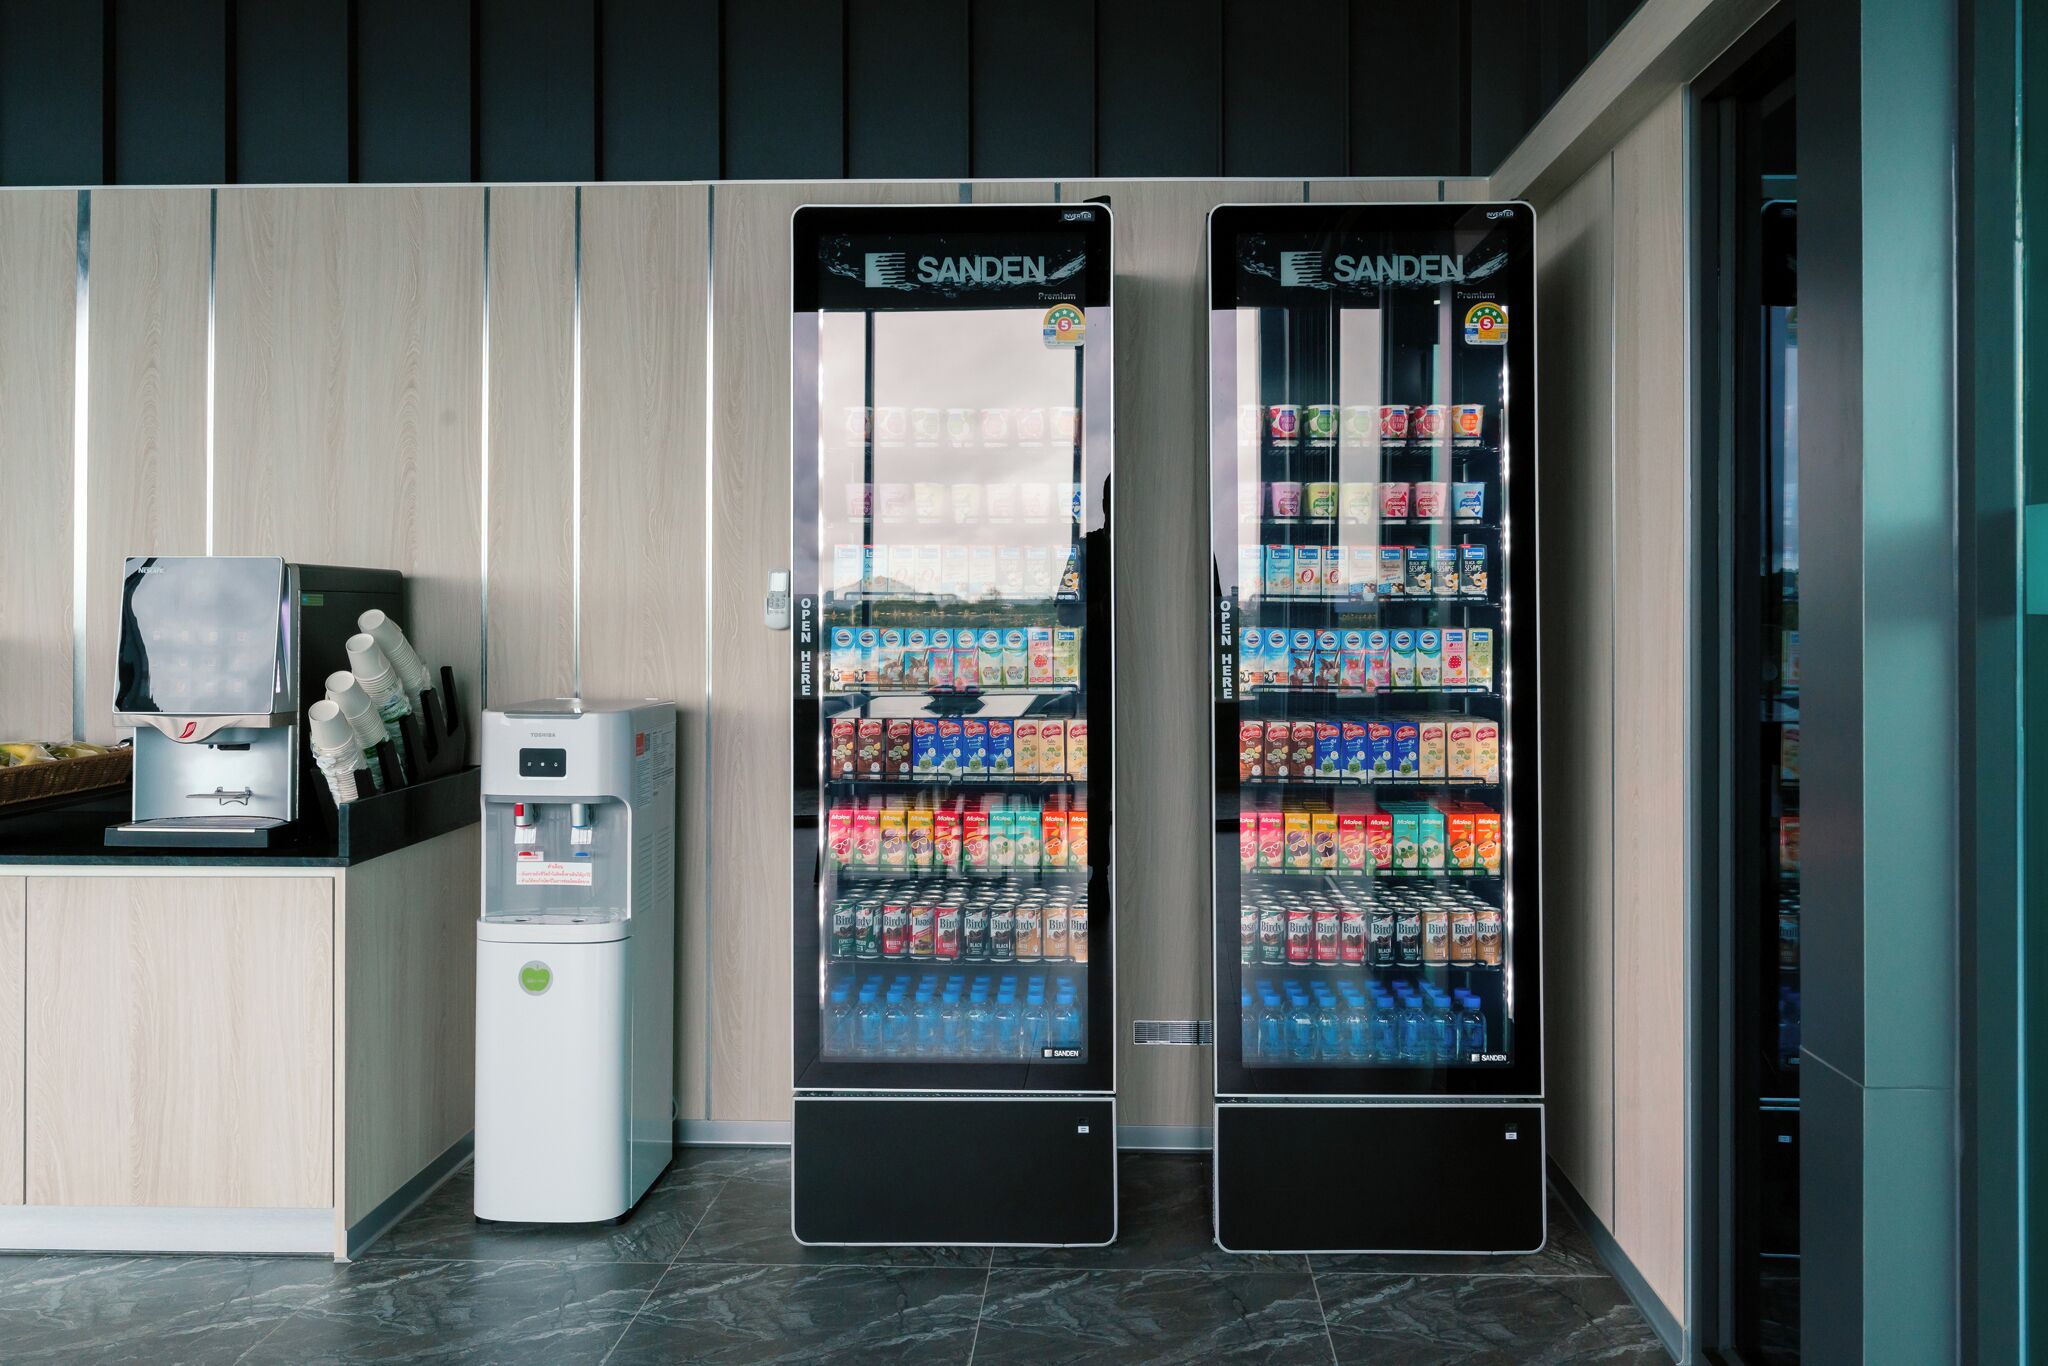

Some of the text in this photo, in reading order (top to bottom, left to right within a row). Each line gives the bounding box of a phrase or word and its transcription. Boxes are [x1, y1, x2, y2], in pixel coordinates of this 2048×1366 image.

[1487, 210, 1513, 219] INVERTER
[917, 255, 1045, 282] SANDEN
[1334, 254, 1464, 282] SANDEN
[1038, 292, 1076, 300] Premium
[1457, 291, 1495, 299] Premium
[1061, 320, 1069, 330] 5
[1483, 318, 1492, 329] 5
[801, 598, 811, 696] OPEN HERE
[1220, 600, 1232, 699] OPEN HERE
[1071, 920, 1088, 930] Bird
[1428, 923, 1448, 934] Bird
